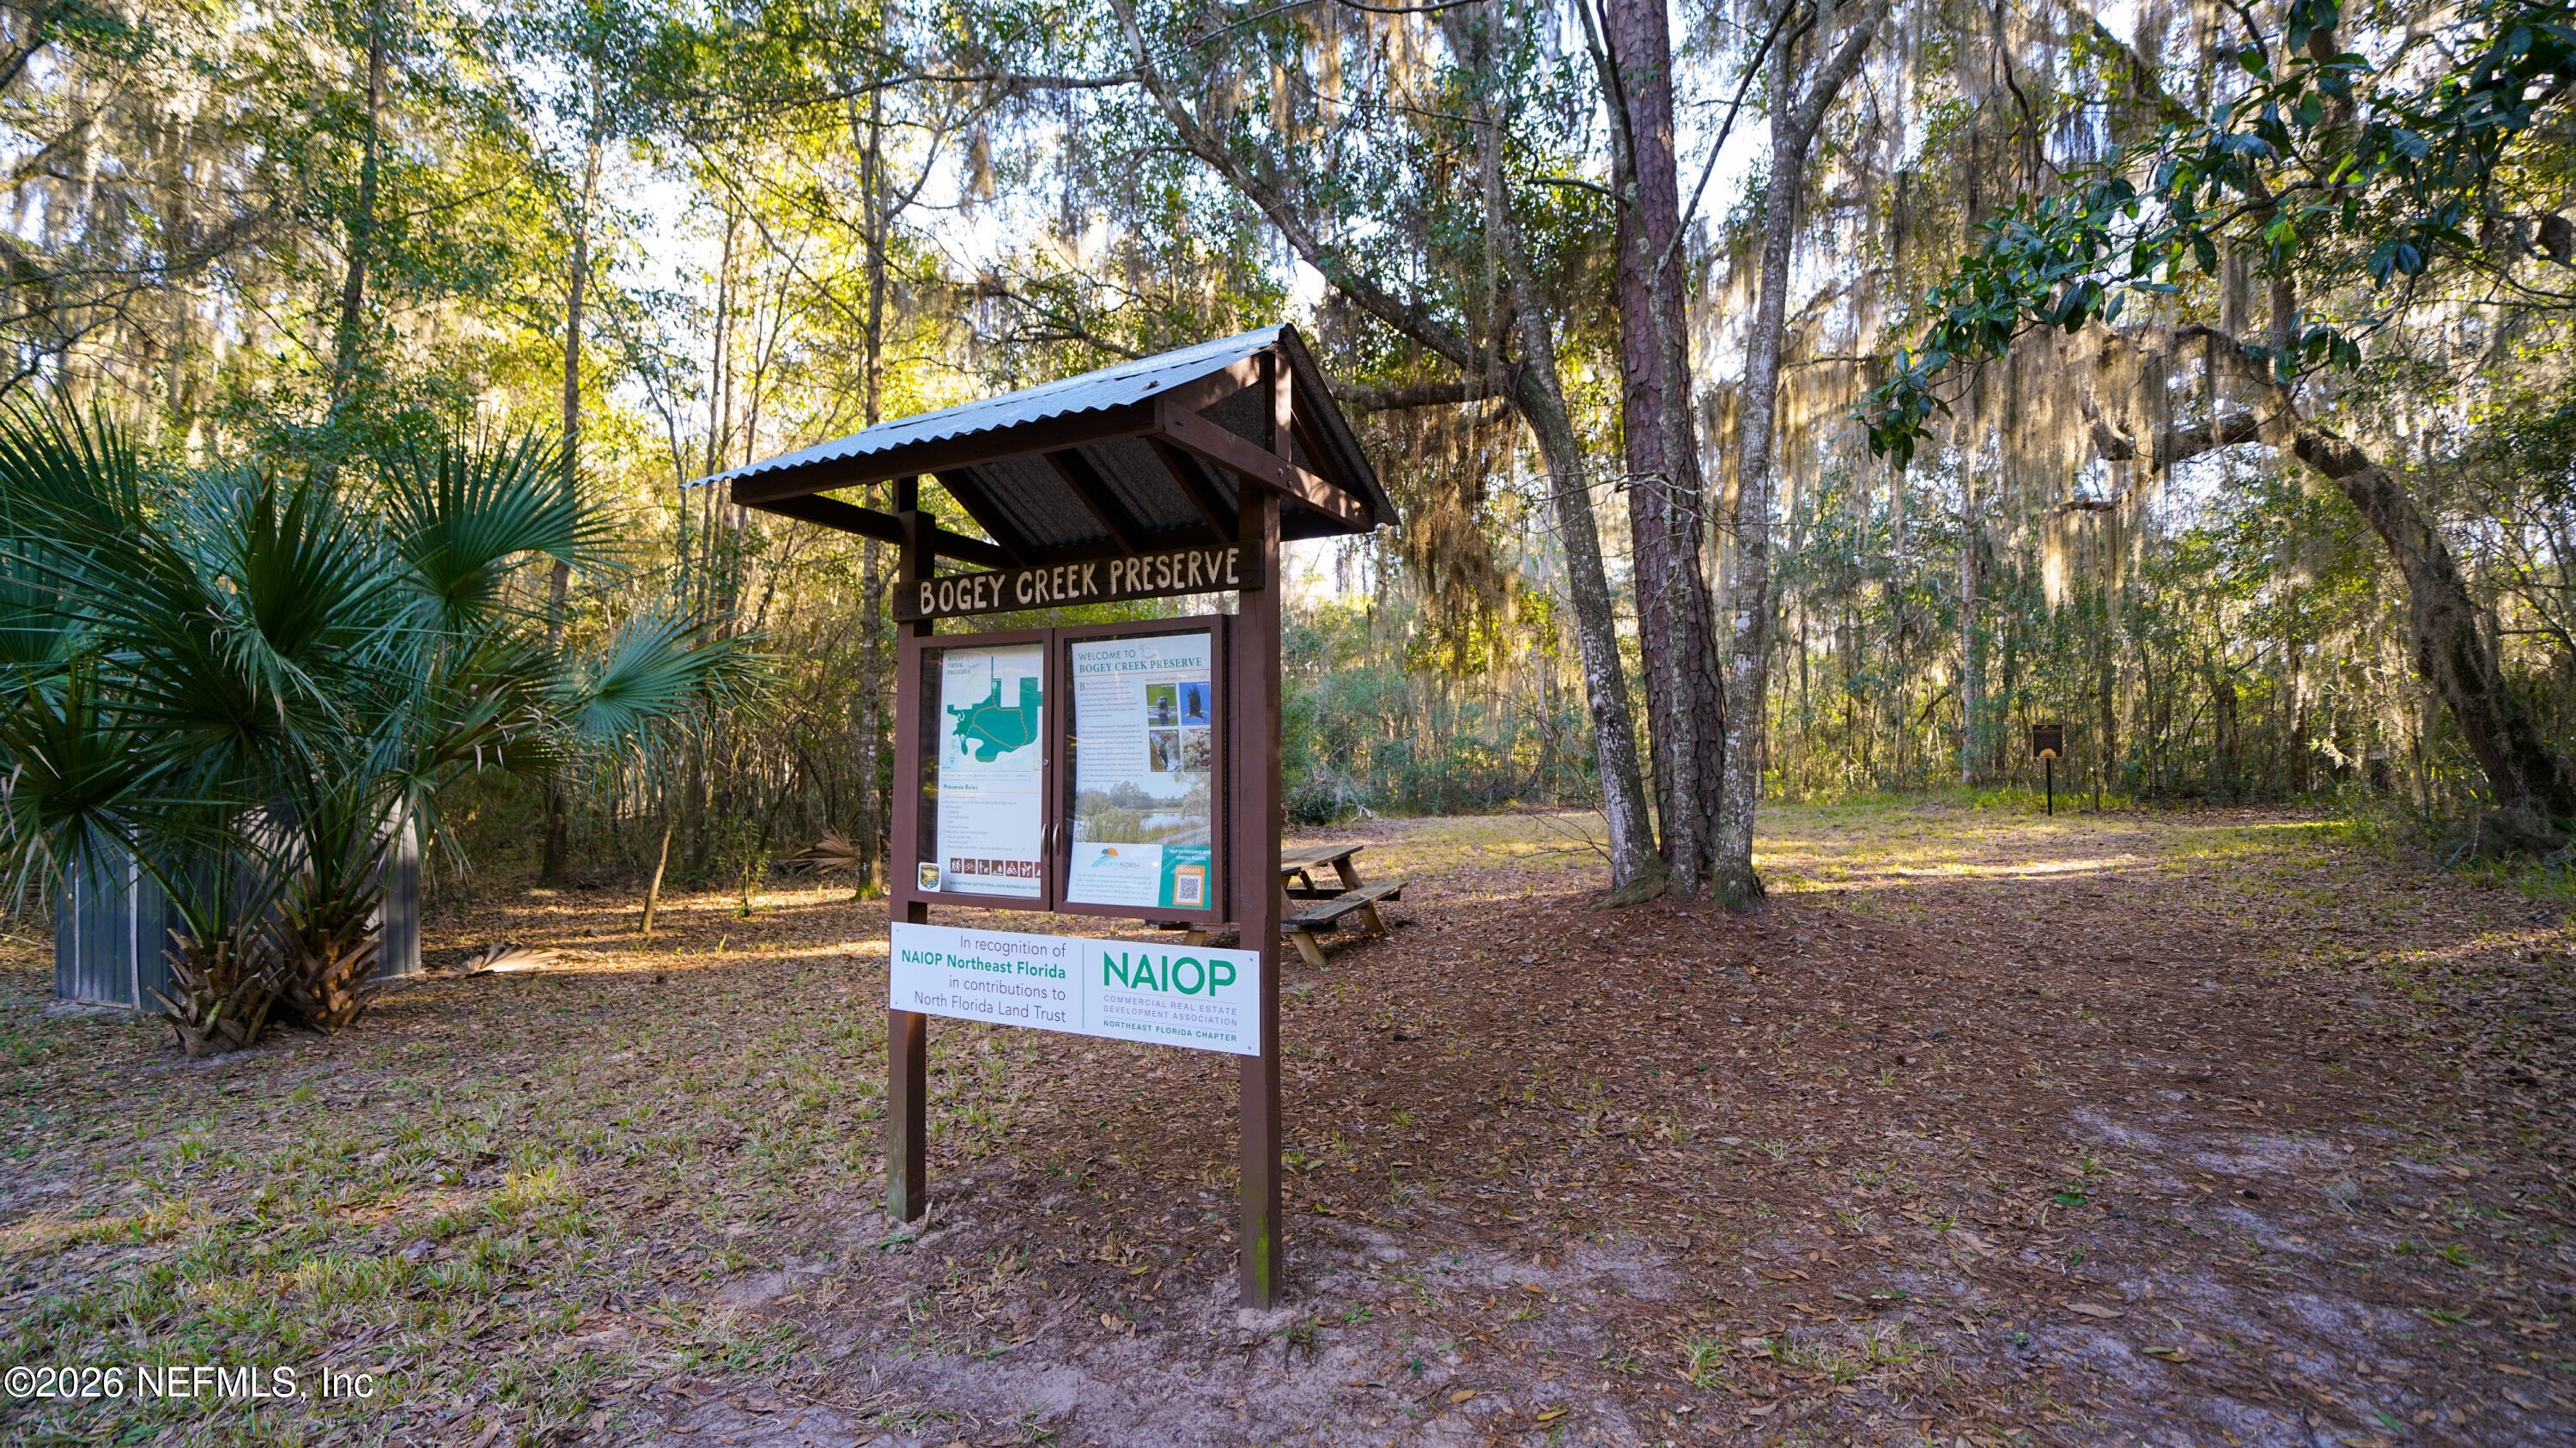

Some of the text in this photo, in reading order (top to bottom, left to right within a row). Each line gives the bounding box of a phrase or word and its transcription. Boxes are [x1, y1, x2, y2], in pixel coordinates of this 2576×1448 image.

[920, 547, 1239, 615] BOGEY CREEK PRESERVE
[1078, 649, 1136, 660] WELCOME TO
[1079, 657, 1203, 673] BOGEY CREEK PRESERVE
[960, 934, 1066, 958] In recognition of
[902, 949, 1066, 979] NAIOP Northeast Florida
[1103, 950, 1236, 997] NAIOP
[949, 975, 1066, 1001] in contributions to
[914, 990, 1066, 1023] North Florida Land Trust
[1103, 995, 1236, 1016] COMMERCIAL REAL ESTATE
[1103, 1005, 1237, 1026] DEVELOPMENT ASSOCIATION
[1103, 1019, 1236, 1043] NORTHEAST FLORIDA CHAPTER
